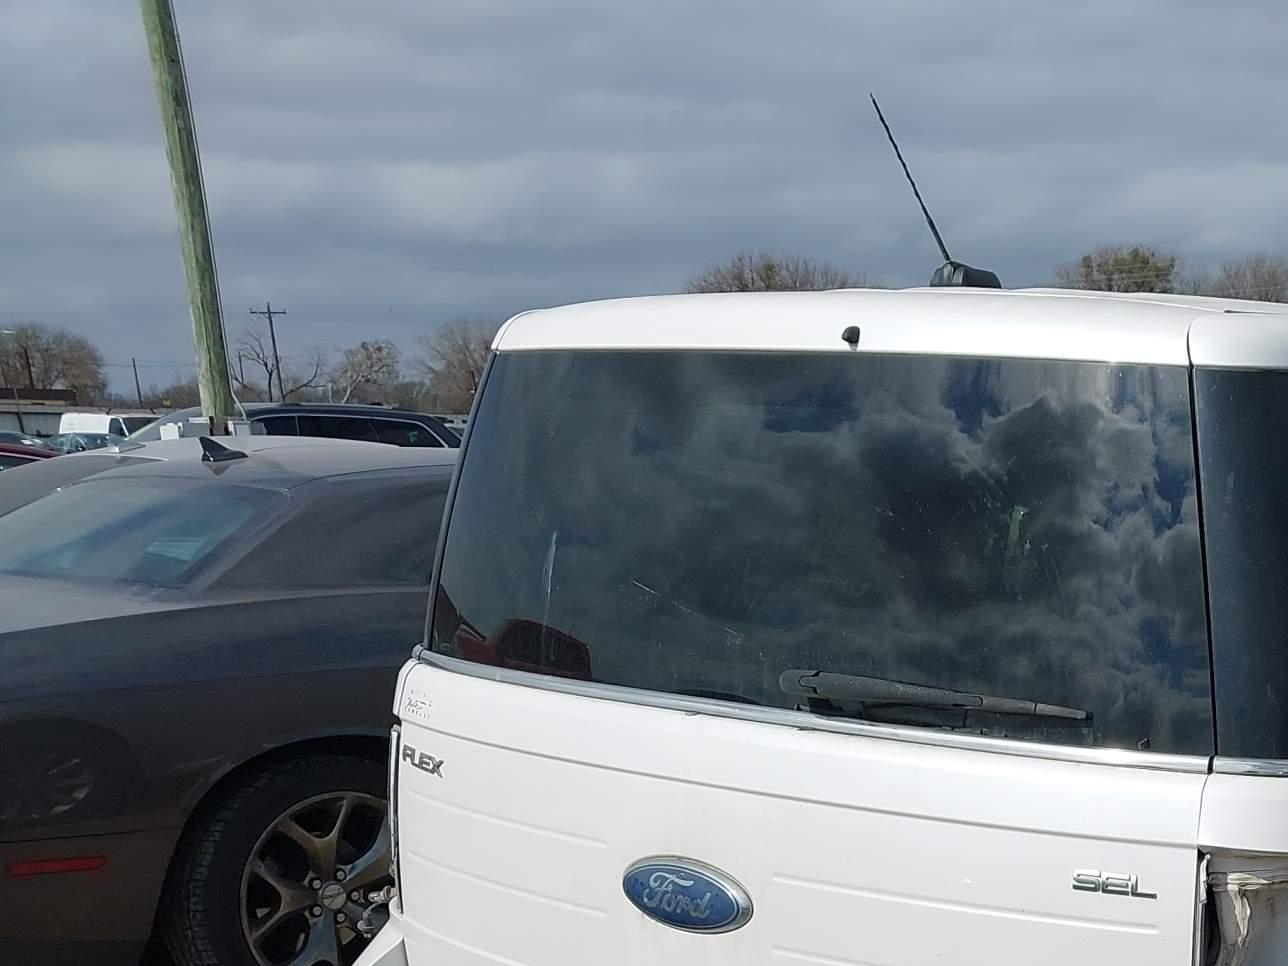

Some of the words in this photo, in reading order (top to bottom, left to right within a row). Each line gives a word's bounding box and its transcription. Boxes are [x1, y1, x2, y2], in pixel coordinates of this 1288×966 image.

[402, 744, 445, 779] FLEX
[643, 871, 712, 919] Ford
[1071, 869, 1159, 900] SEL
